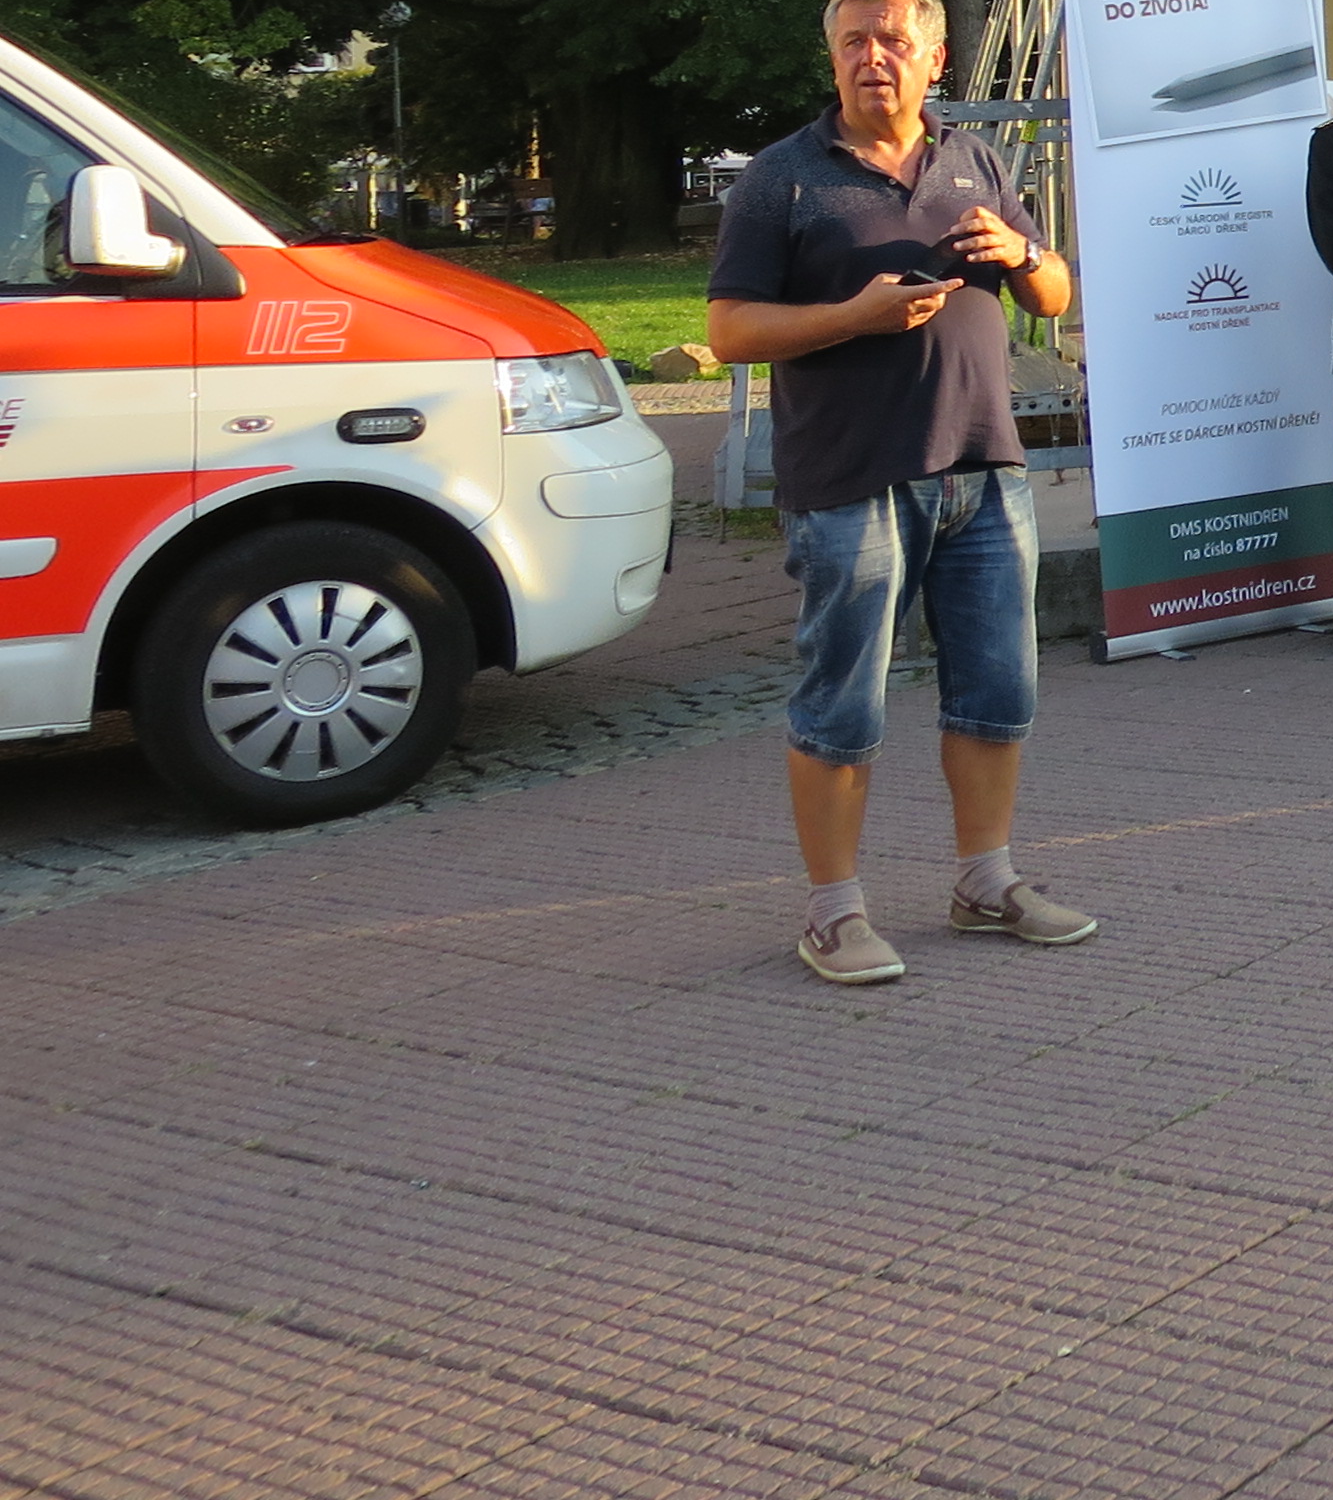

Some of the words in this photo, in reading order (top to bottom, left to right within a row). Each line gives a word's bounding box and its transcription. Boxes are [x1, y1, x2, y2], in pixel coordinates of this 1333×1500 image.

[1104, 2, 1135, 21] DO
[247, 300, 353, 355] 112
[1169, 429, 1183, 444] SE
[1184, 421, 1235, 442] DÁRCEM
[1237, 414, 1278, 434] KOSTNÍ
[1169, 521, 1202, 539] DMS
[1204, 506, 1289, 532] KOSTNIDREN
[1183, 548, 1201, 562] na
[1203, 541, 1233, 558] číslo
[1235, 532, 1279, 552] 87777
[1150, 573, 1316, 618] www.kostnidren.cz
